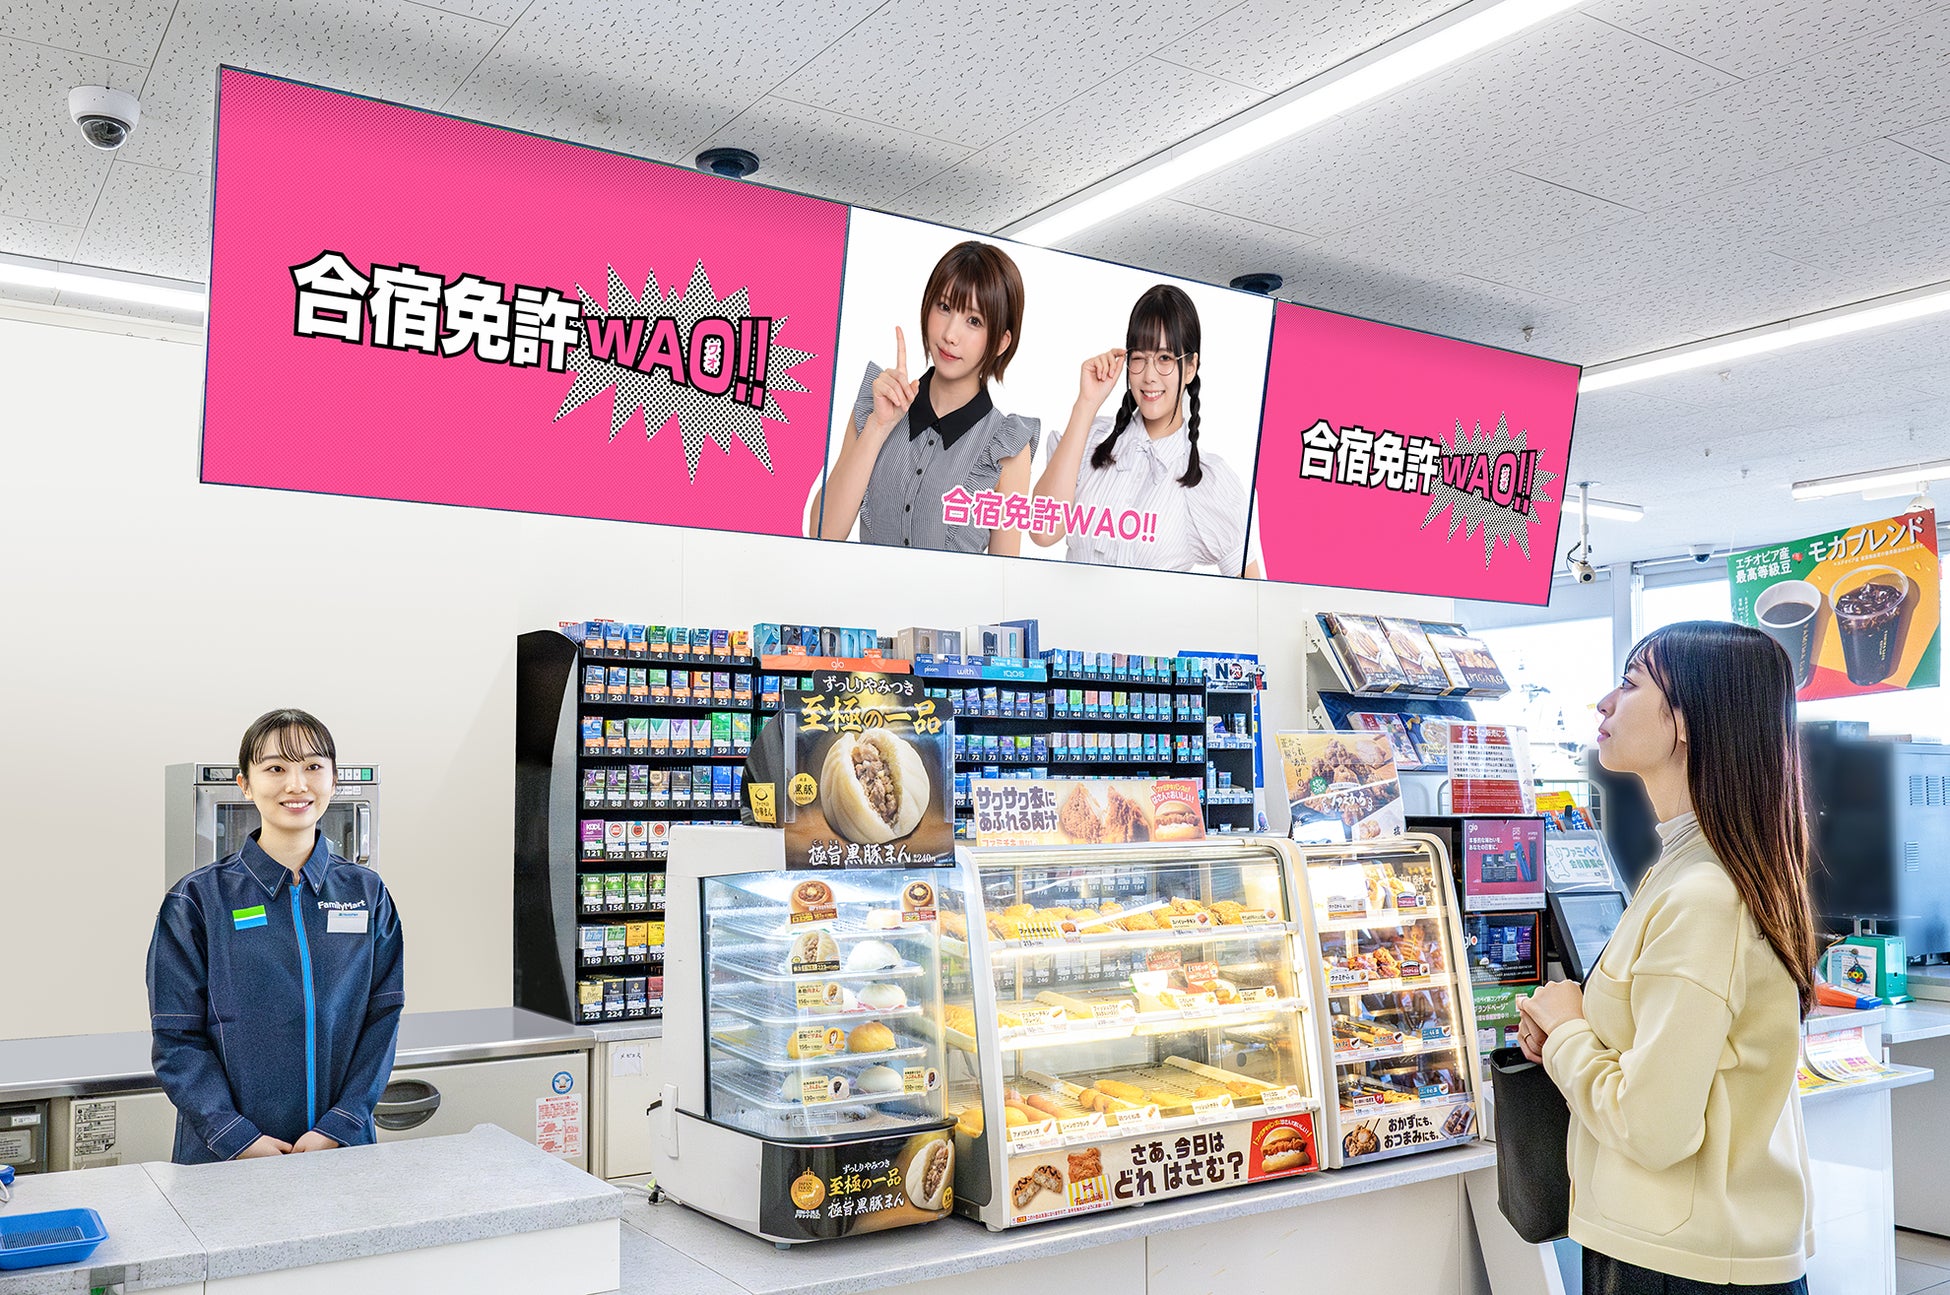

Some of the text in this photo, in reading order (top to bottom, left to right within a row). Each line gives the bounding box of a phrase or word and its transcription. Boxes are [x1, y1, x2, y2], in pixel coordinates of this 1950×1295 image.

[1808, 516, 1924, 562] モカブレンド
[1736, 547, 1790, 570] エチオピア産
[1736, 562, 1792, 584] 最高等級豆
[831, 658, 844, 670] glo
[823, 676, 914, 696] ずっしりやみつき
[800, 694, 942, 736] 至極の一品
[795, 784, 813, 795] 黒豚
[976, 786, 1056, 810] サクサク衣に
[979, 810, 1058, 832] あふれる肉汁
[1468, 824, 1478, 833] glo
[808, 844, 911, 865] 極旨黒豚まん
[1561, 846, 1599, 857] ファミペイ
[318, 900, 366, 910] FamilyMart
[1388, 1114, 1433, 1132] おかずにも、
[1131, 1132, 1225, 1166] さあ、今日は
[843, 1159, 890, 1174] ずっしりやみつき
[828, 1168, 902, 1197] 至極の一品
[1115, 1167, 1157, 1200] どれ
[828, 1192, 904, 1218] 極旨黒豚まん
